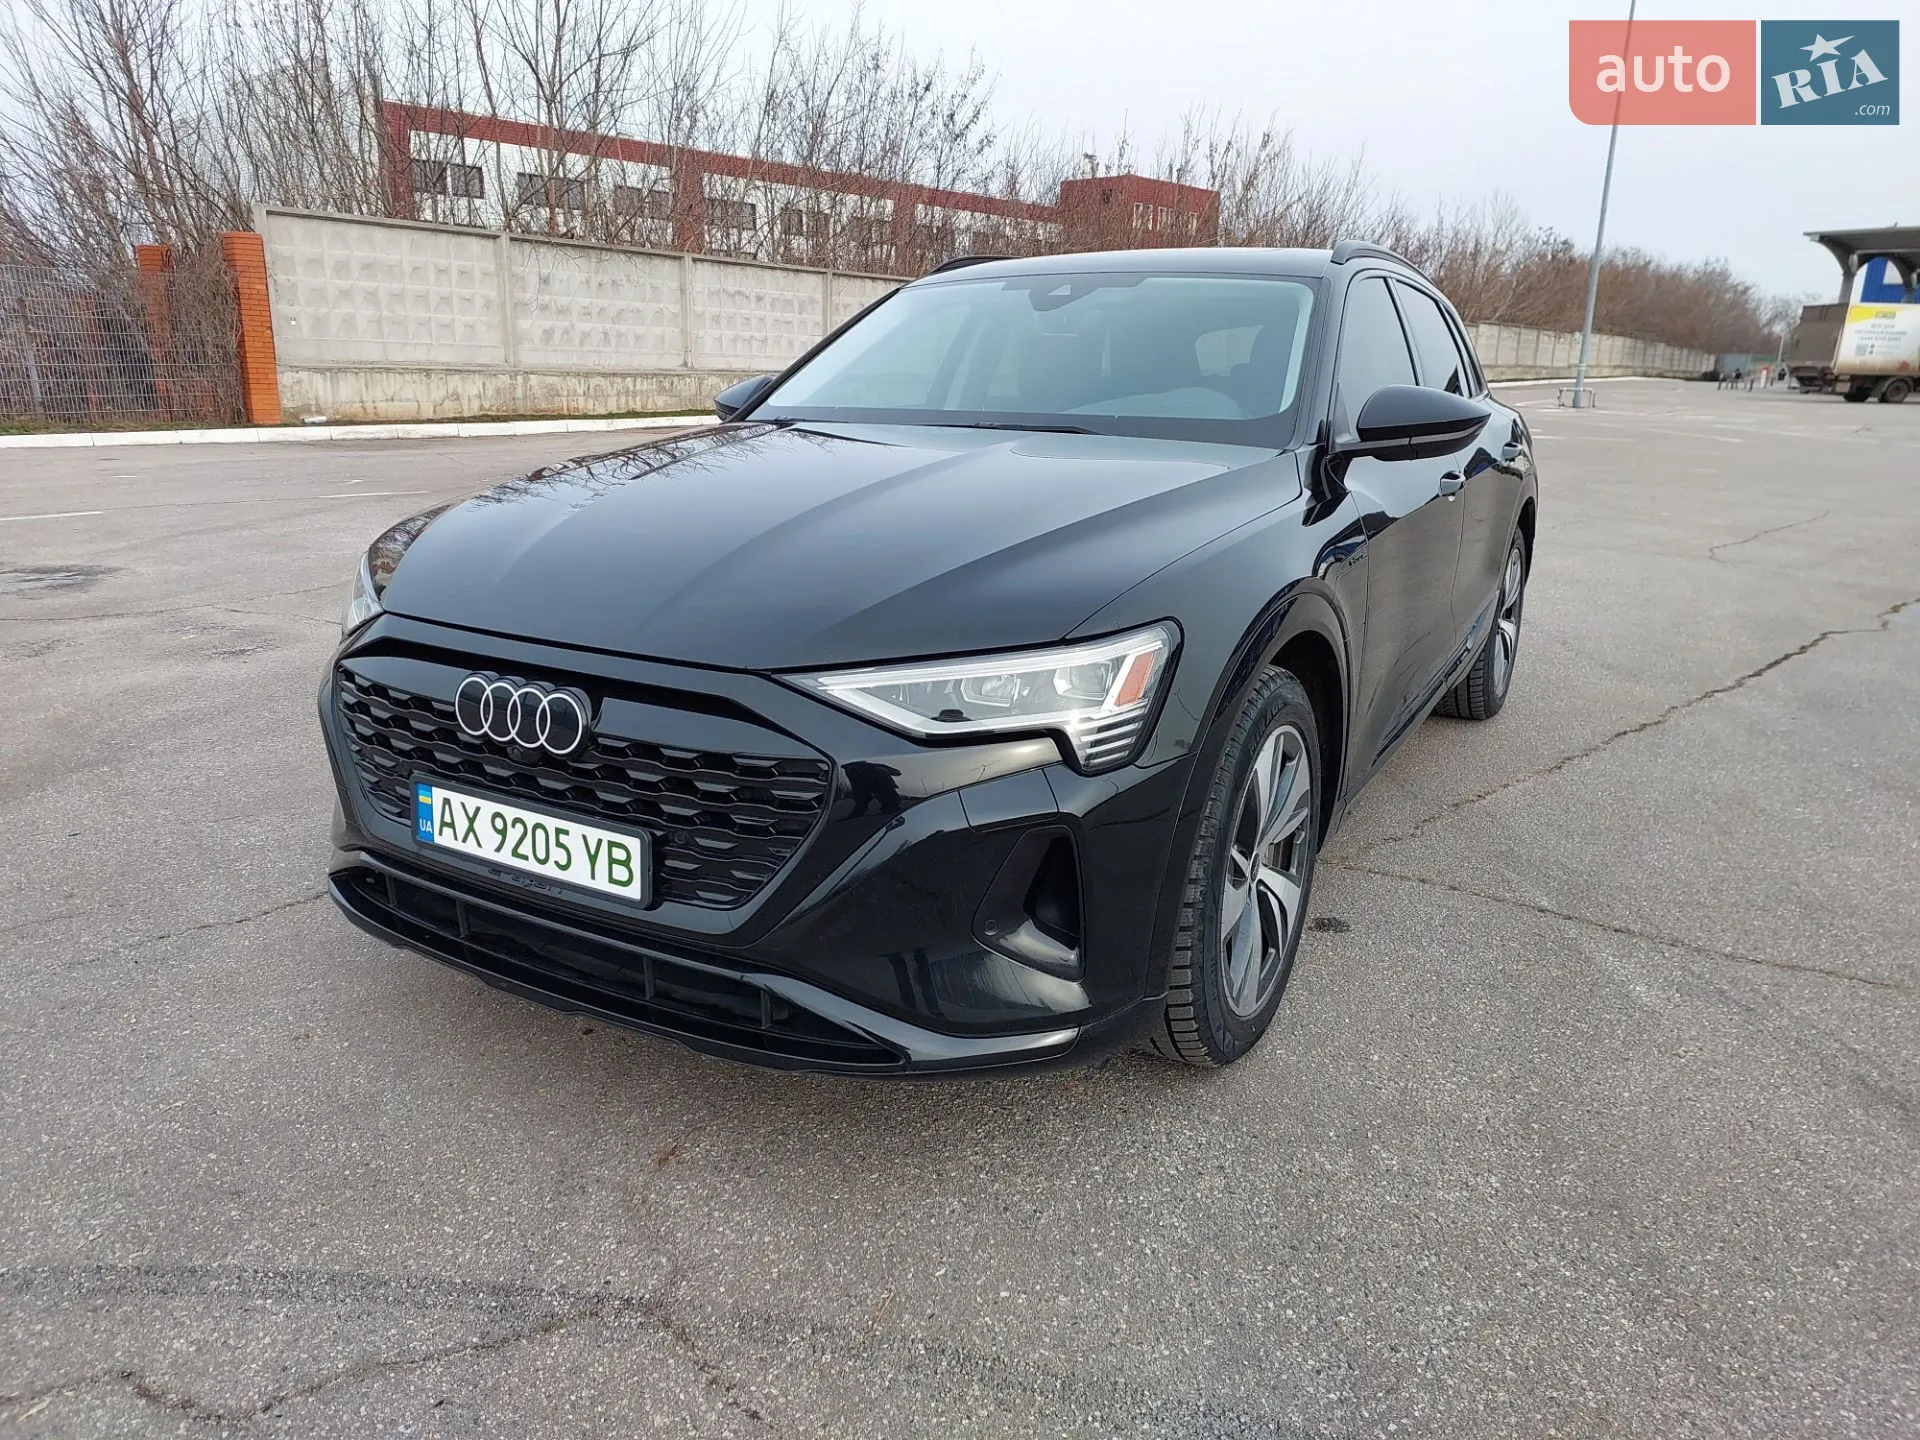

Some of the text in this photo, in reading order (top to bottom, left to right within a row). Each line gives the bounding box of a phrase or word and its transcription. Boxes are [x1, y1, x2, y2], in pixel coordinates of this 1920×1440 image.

[419, 818, 433, 834] UA
[438, 797, 483, 849] AX
[490, 811, 572, 872] 9205
[582, 833, 634, 888] YB
